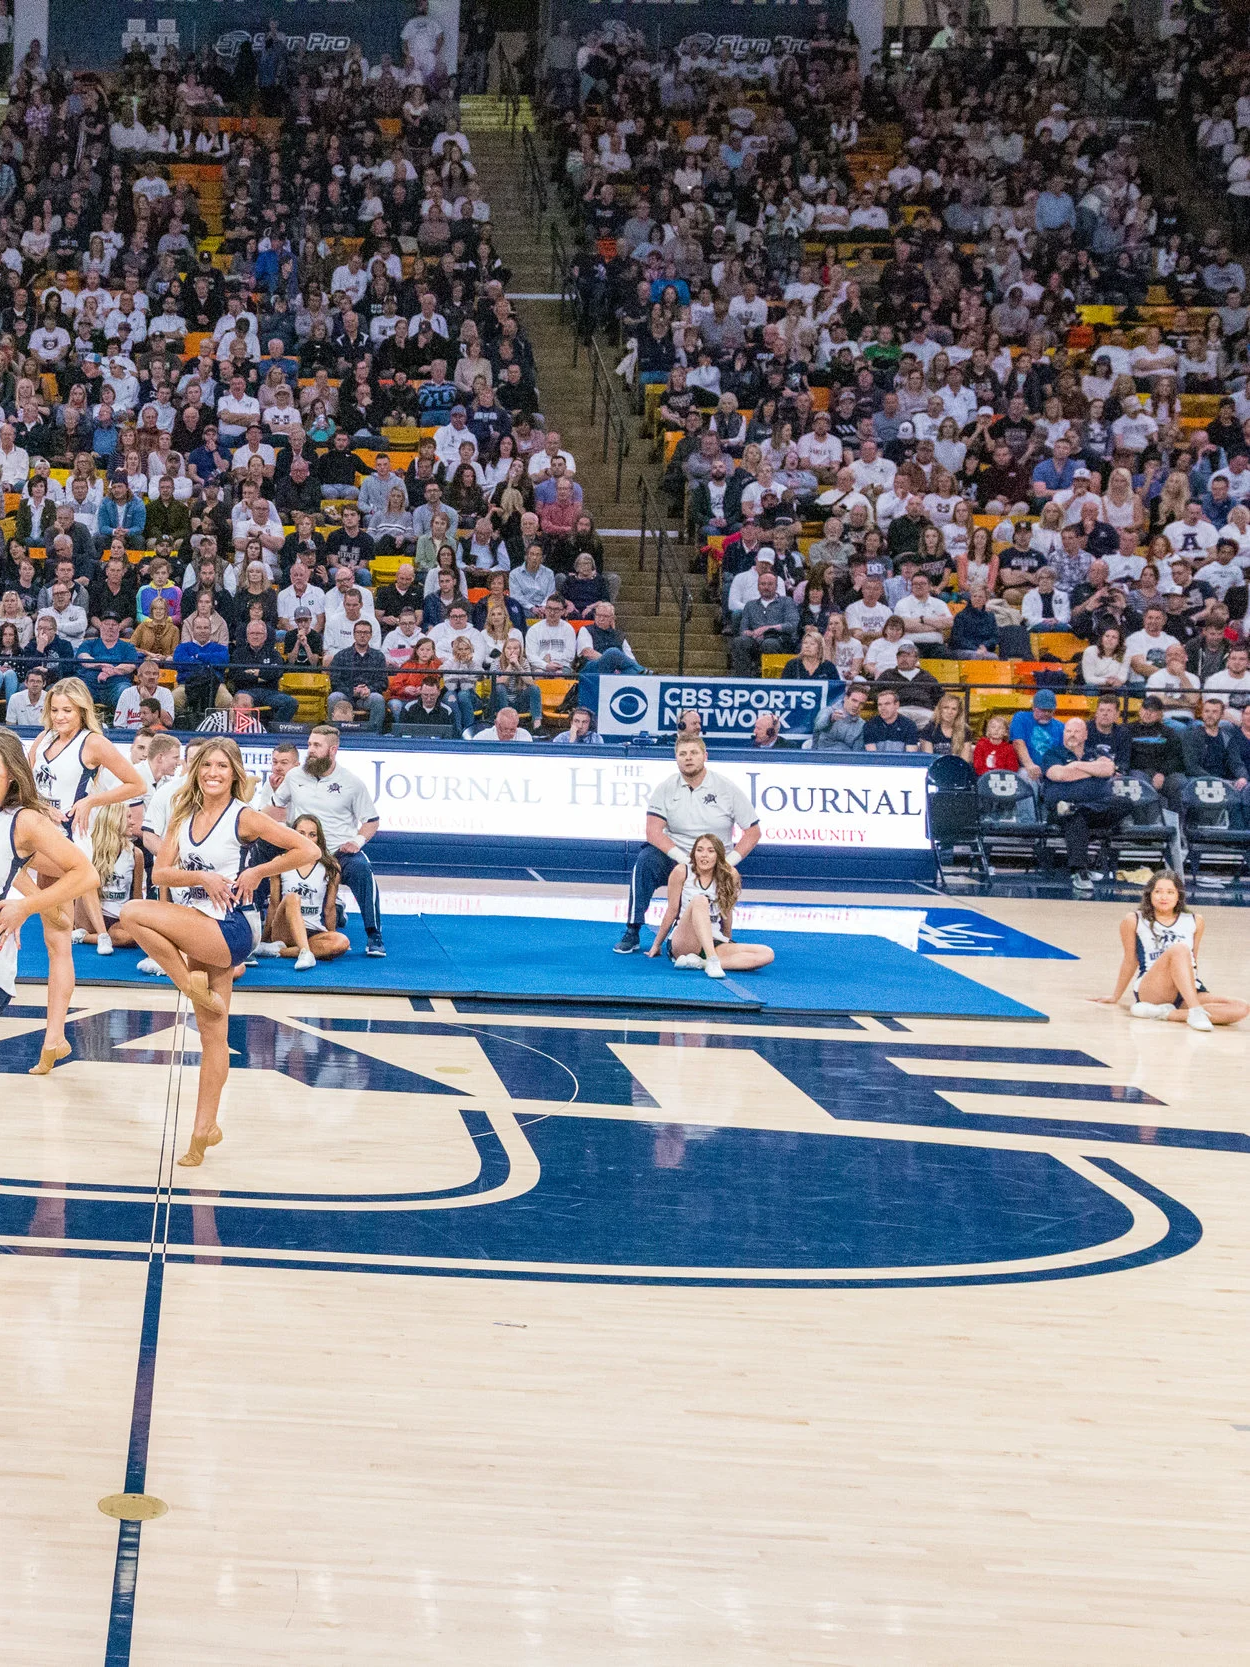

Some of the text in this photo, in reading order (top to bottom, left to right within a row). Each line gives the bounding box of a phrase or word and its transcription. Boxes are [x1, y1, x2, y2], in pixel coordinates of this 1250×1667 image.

[306, 32, 351, 51] Pro
[664, 687, 817, 710] CBS SPORTS
[614, 765, 644, 777] THE
[371, 760, 542, 804] JOURNAL
[746, 772, 922, 816] JOURNAL
[765, 827, 867, 843] COMMUNITY
